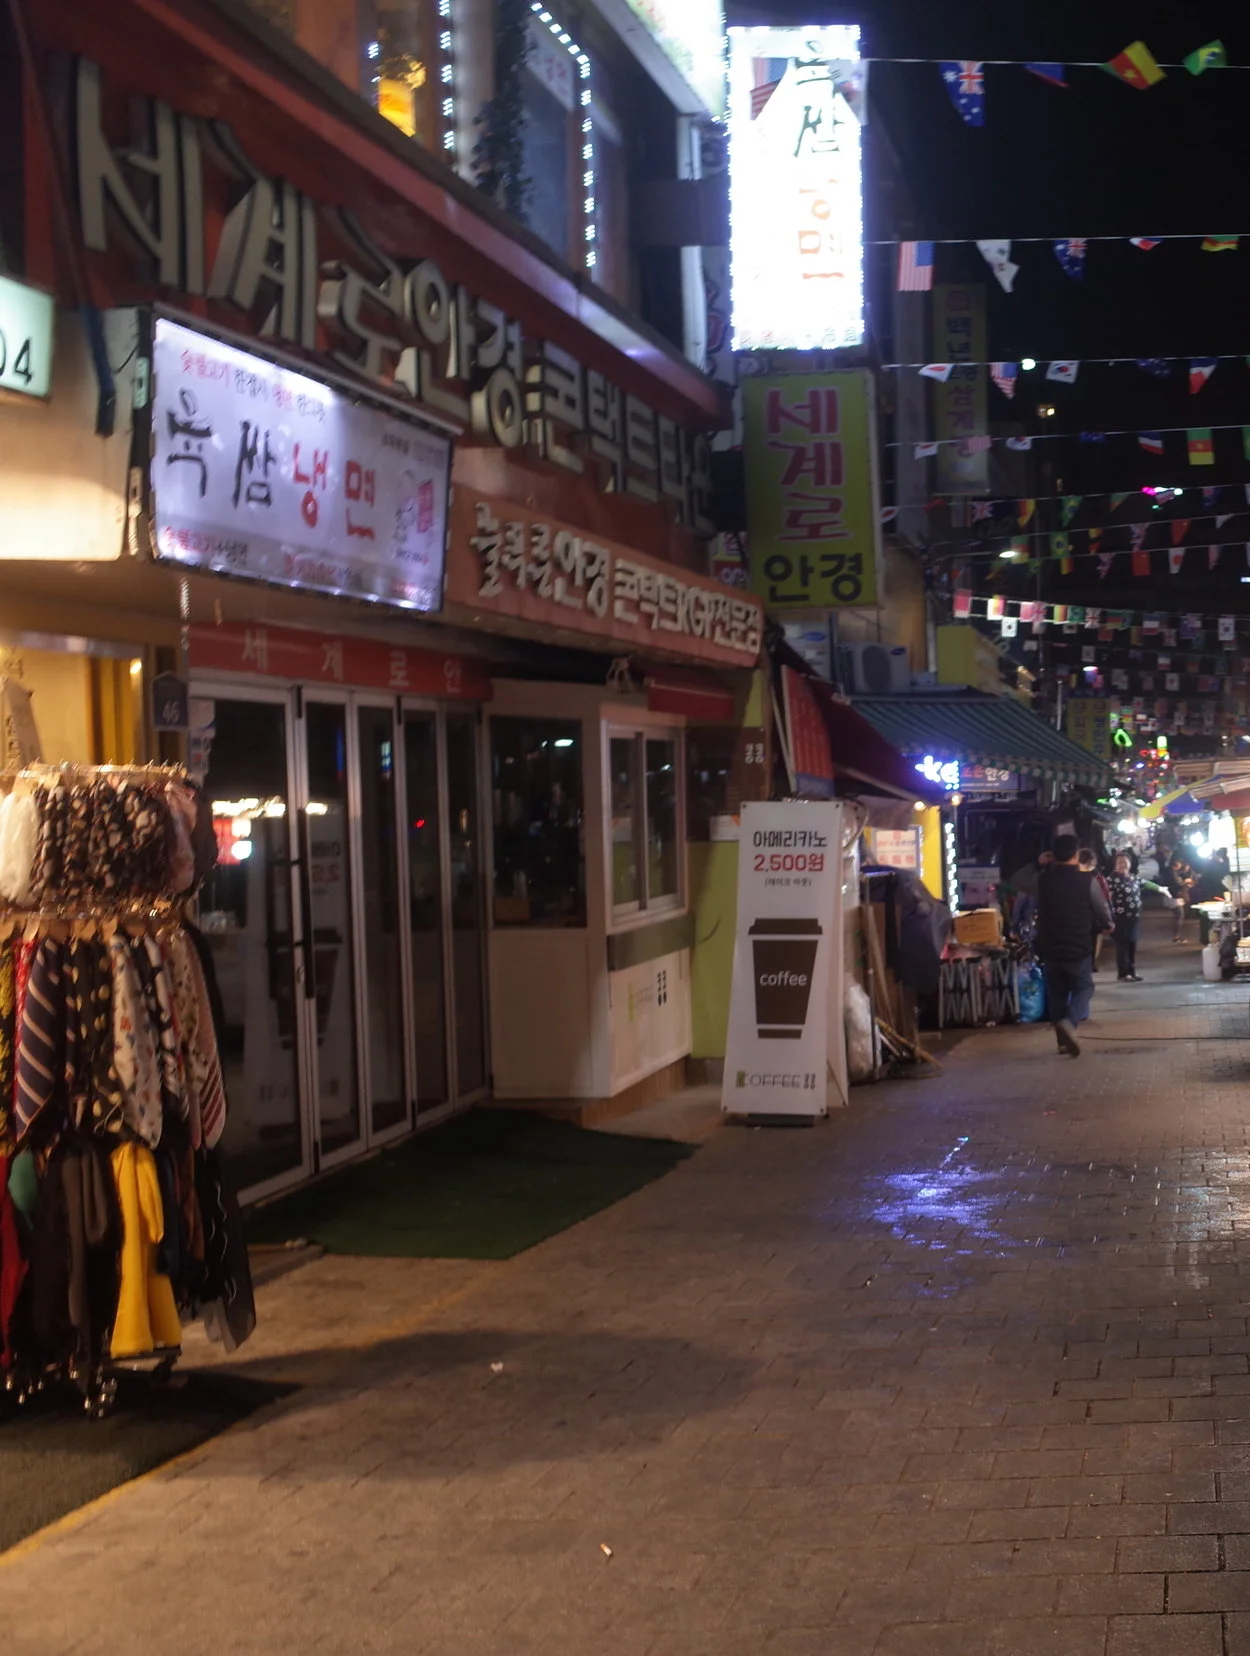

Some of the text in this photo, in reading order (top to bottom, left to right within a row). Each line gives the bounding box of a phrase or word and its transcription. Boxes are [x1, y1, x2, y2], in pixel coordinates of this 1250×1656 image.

[764, 387, 854, 542] 세계로
[762, 552, 864, 604] 안경
[753, 830, 828, 848] 아메리카노
[753, 853, 825, 873] 2,500원
[759, 970, 808, 987] coffee
